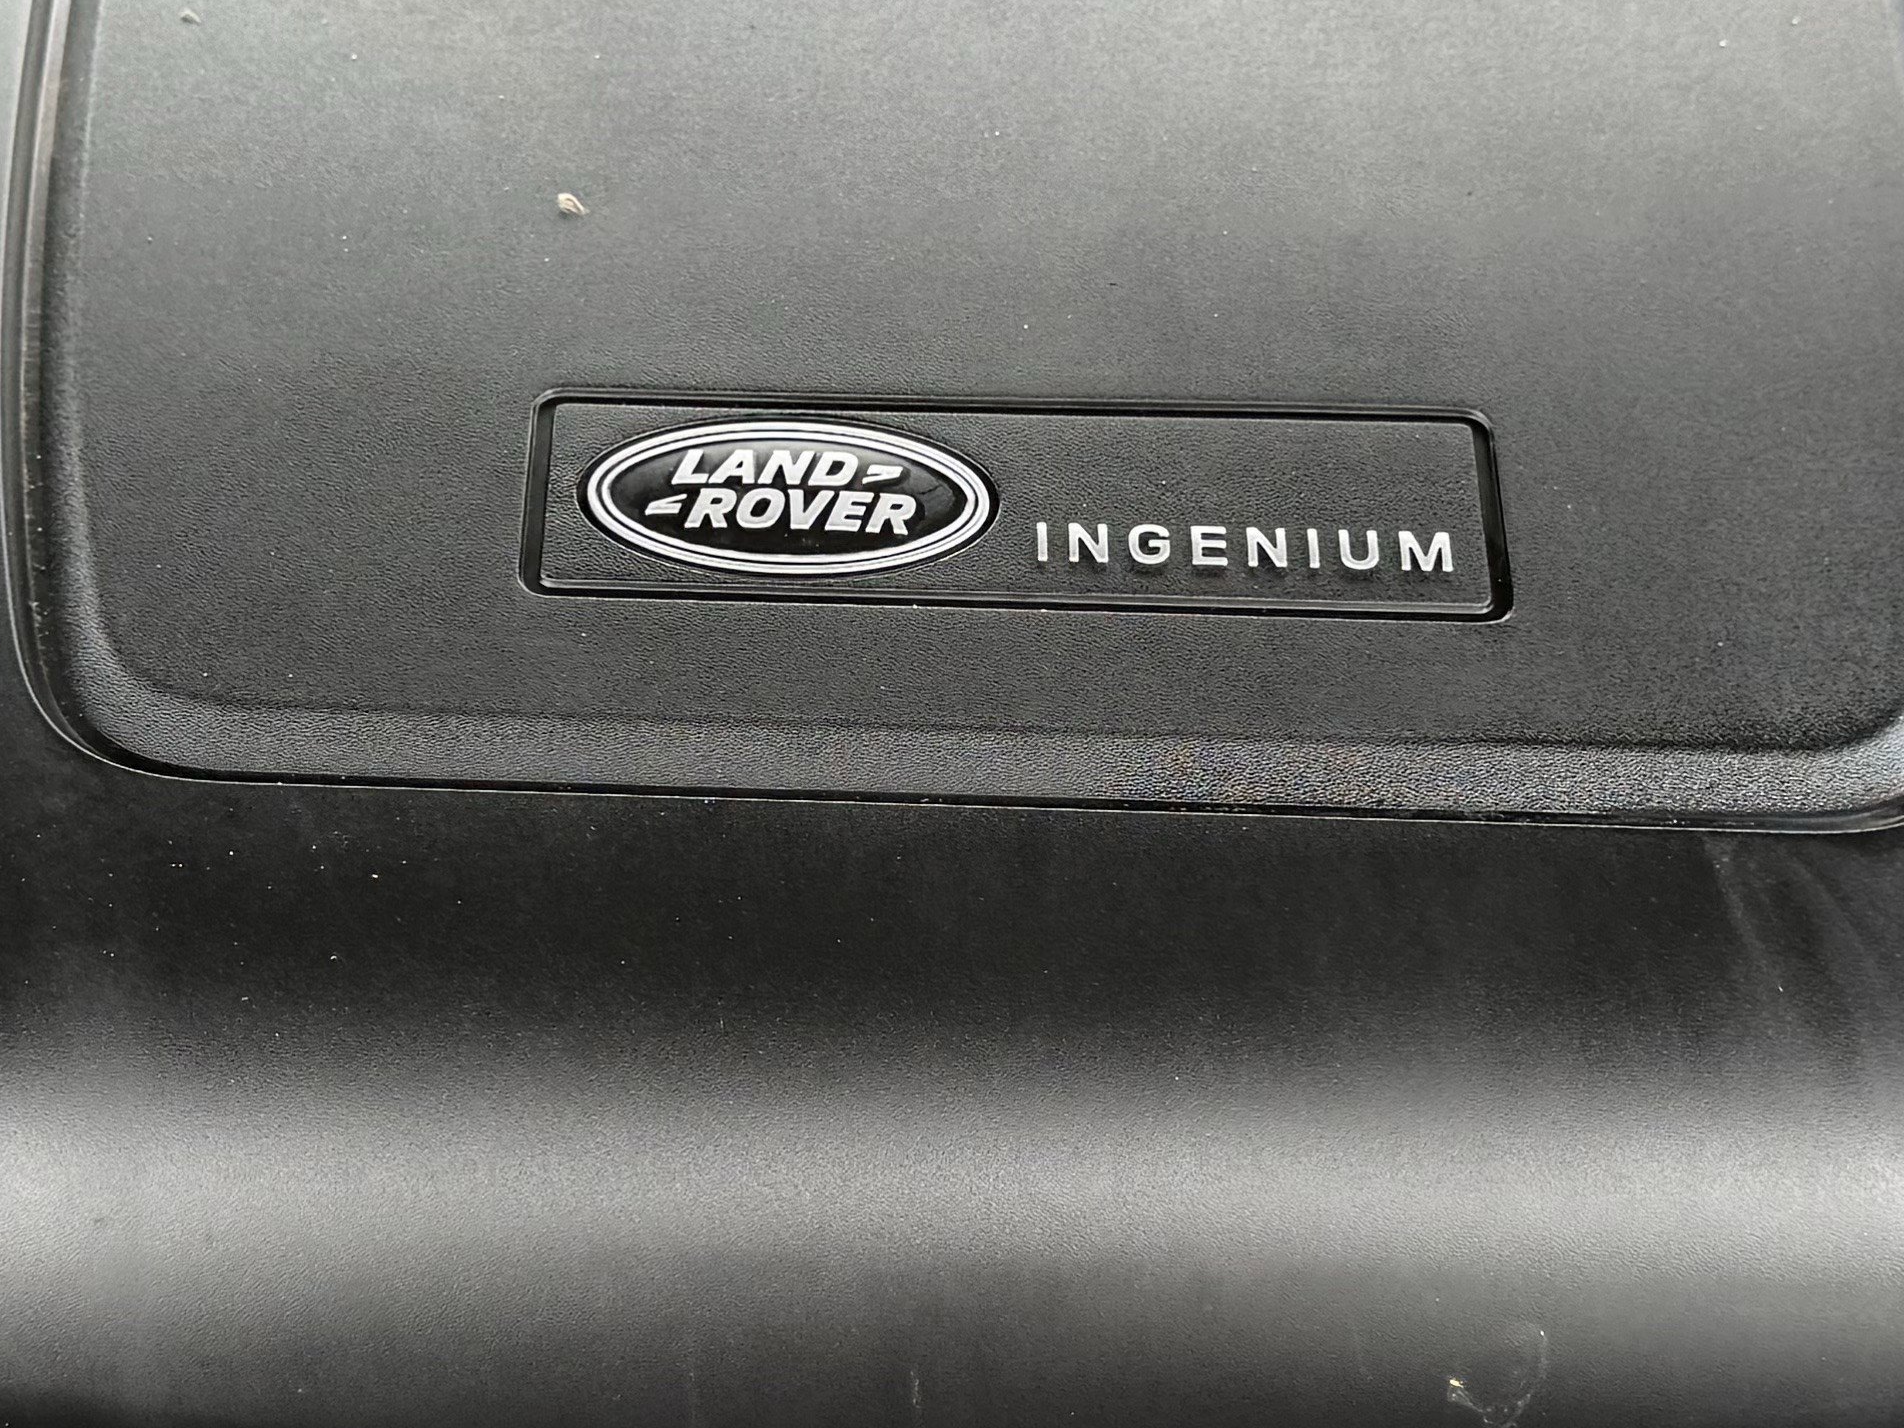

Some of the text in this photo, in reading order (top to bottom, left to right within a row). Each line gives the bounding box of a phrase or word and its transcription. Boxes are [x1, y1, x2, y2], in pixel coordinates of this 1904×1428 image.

[671, 448, 859, 486] LAND
[684, 487, 918, 536] ROVER
[1035, 521, 1454, 572] INGENIUM
